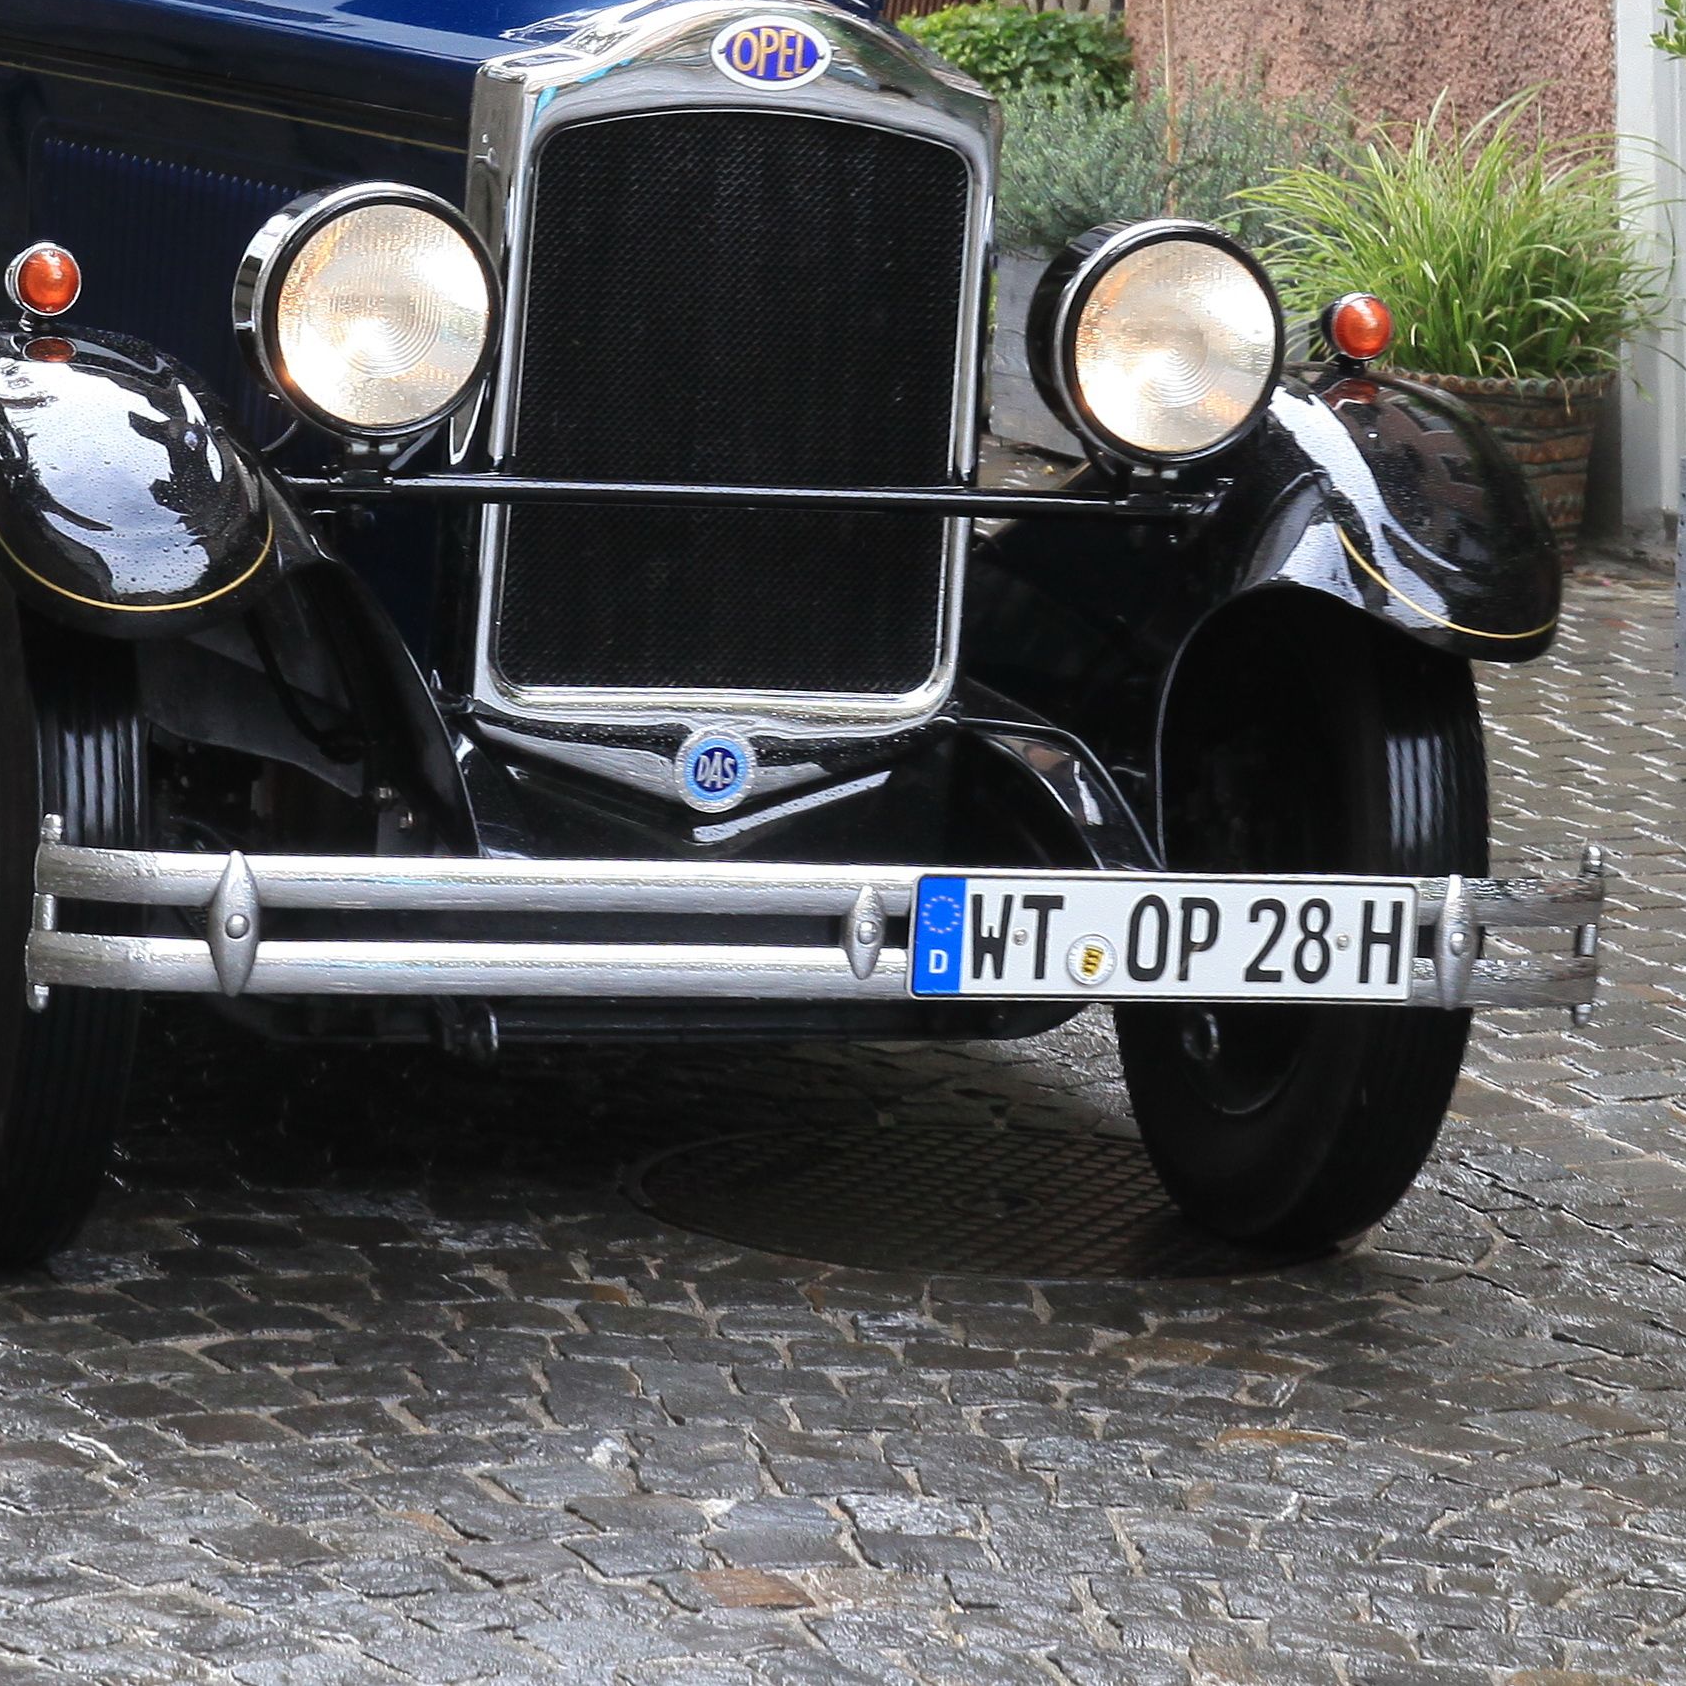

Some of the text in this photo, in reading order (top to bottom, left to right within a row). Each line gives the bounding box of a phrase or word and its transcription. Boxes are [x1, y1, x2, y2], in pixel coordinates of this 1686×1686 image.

[732, 28, 808, 78] OPEL
[696, 751, 735, 789] DAS
[971, 894, 1064, 980] WT
[1127, 894, 1220, 982] OP
[928, 950, 948, 974] D
